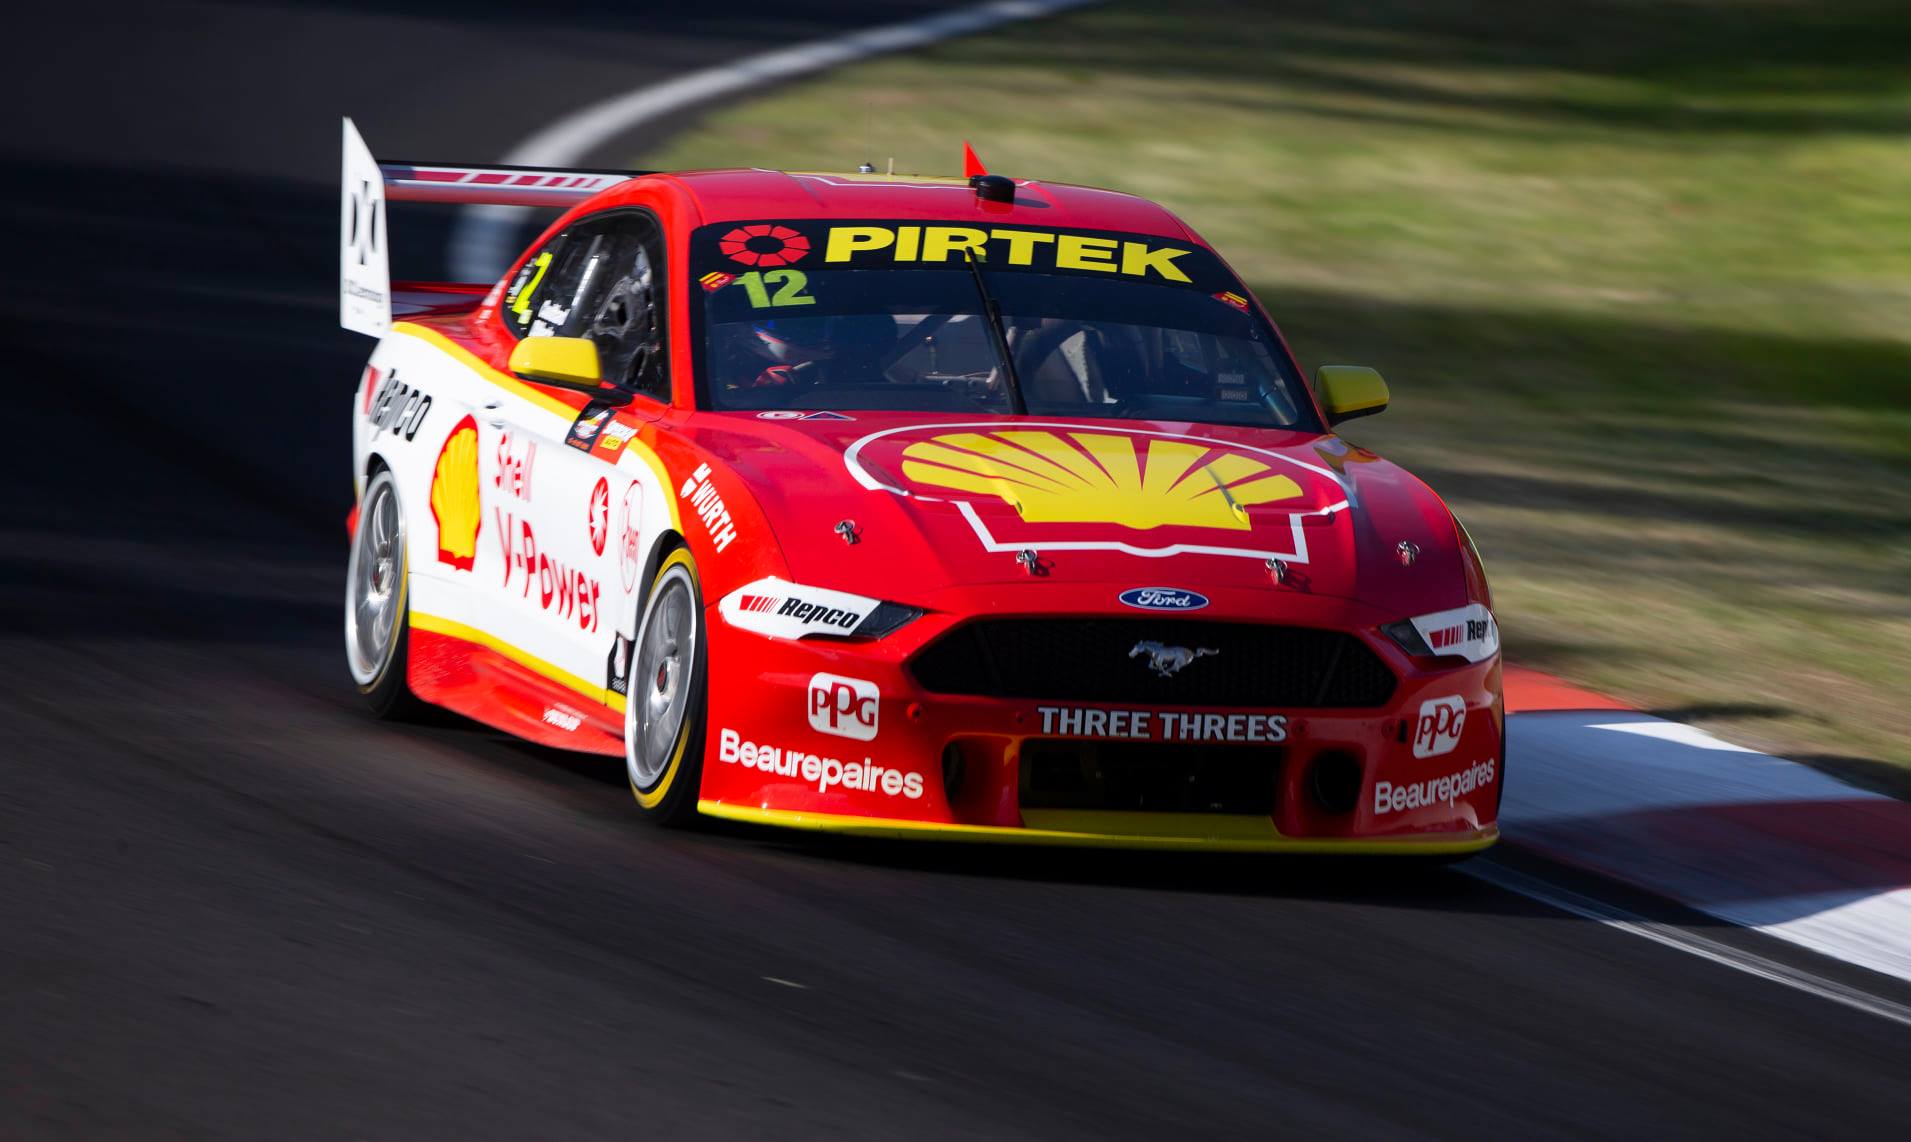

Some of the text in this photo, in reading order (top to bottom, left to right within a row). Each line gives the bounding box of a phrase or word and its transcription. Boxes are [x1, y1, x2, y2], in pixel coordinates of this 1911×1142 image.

[825, 226, 1193, 284] PIRTEK
[732, 269, 816, 308] 12
[496, 432, 536, 502] Shell
[495, 506, 600, 633] V-Power
[1137, 588, 1191, 607] Ford
[777, 597, 861, 627] Repco
[1038, 706, 1289, 743] THREE THREES
[719, 728, 924, 799] Beaurepaires
[1375, 757, 1495, 815] Beaurepaires
